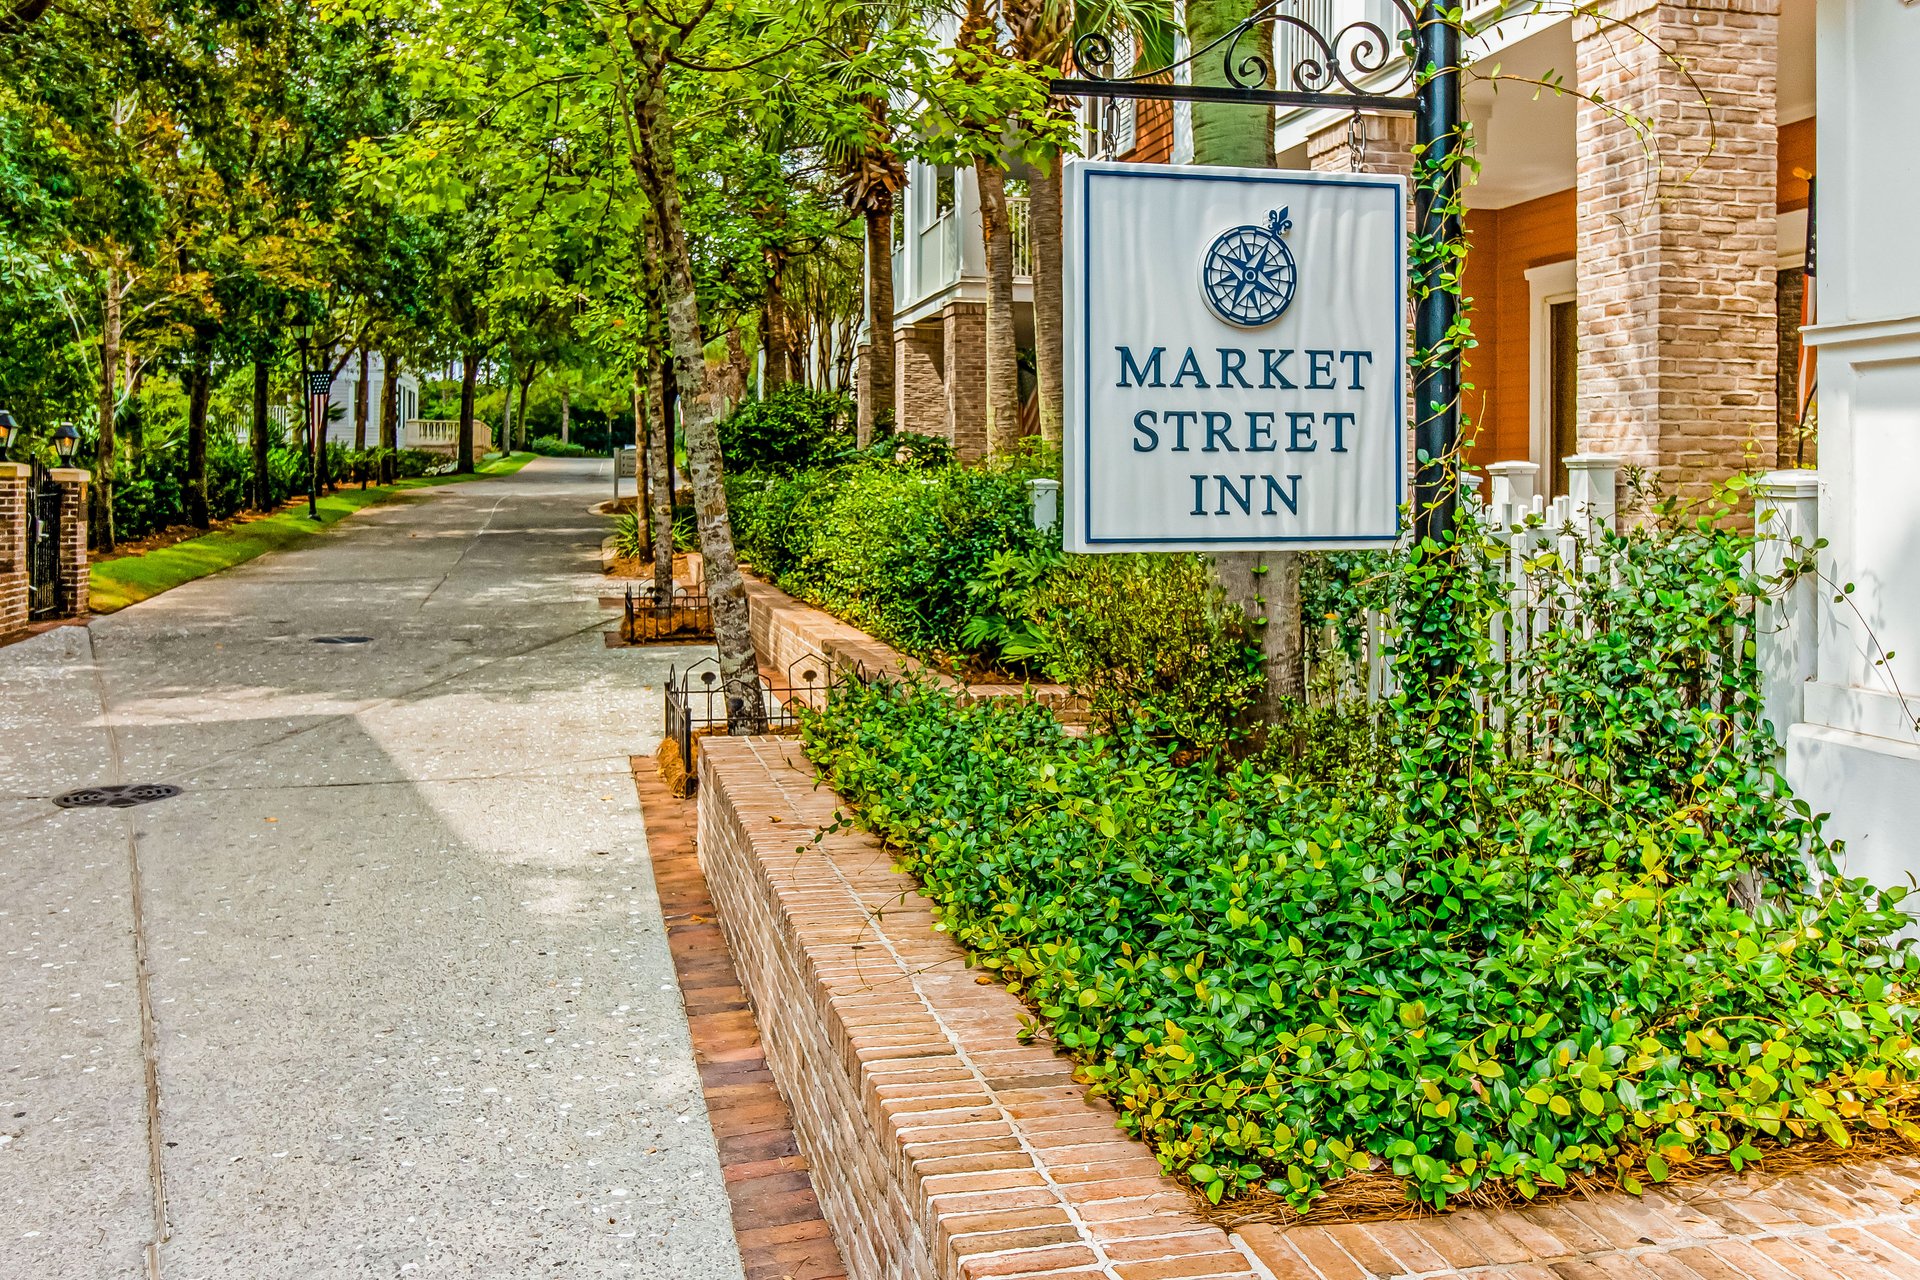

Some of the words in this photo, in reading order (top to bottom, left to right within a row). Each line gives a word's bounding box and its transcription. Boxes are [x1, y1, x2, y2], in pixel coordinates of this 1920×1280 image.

[1114, 346, 1373, 391] MARKET
[1133, 409, 1356, 453] STREET
[1189, 474, 1303, 516] INN
